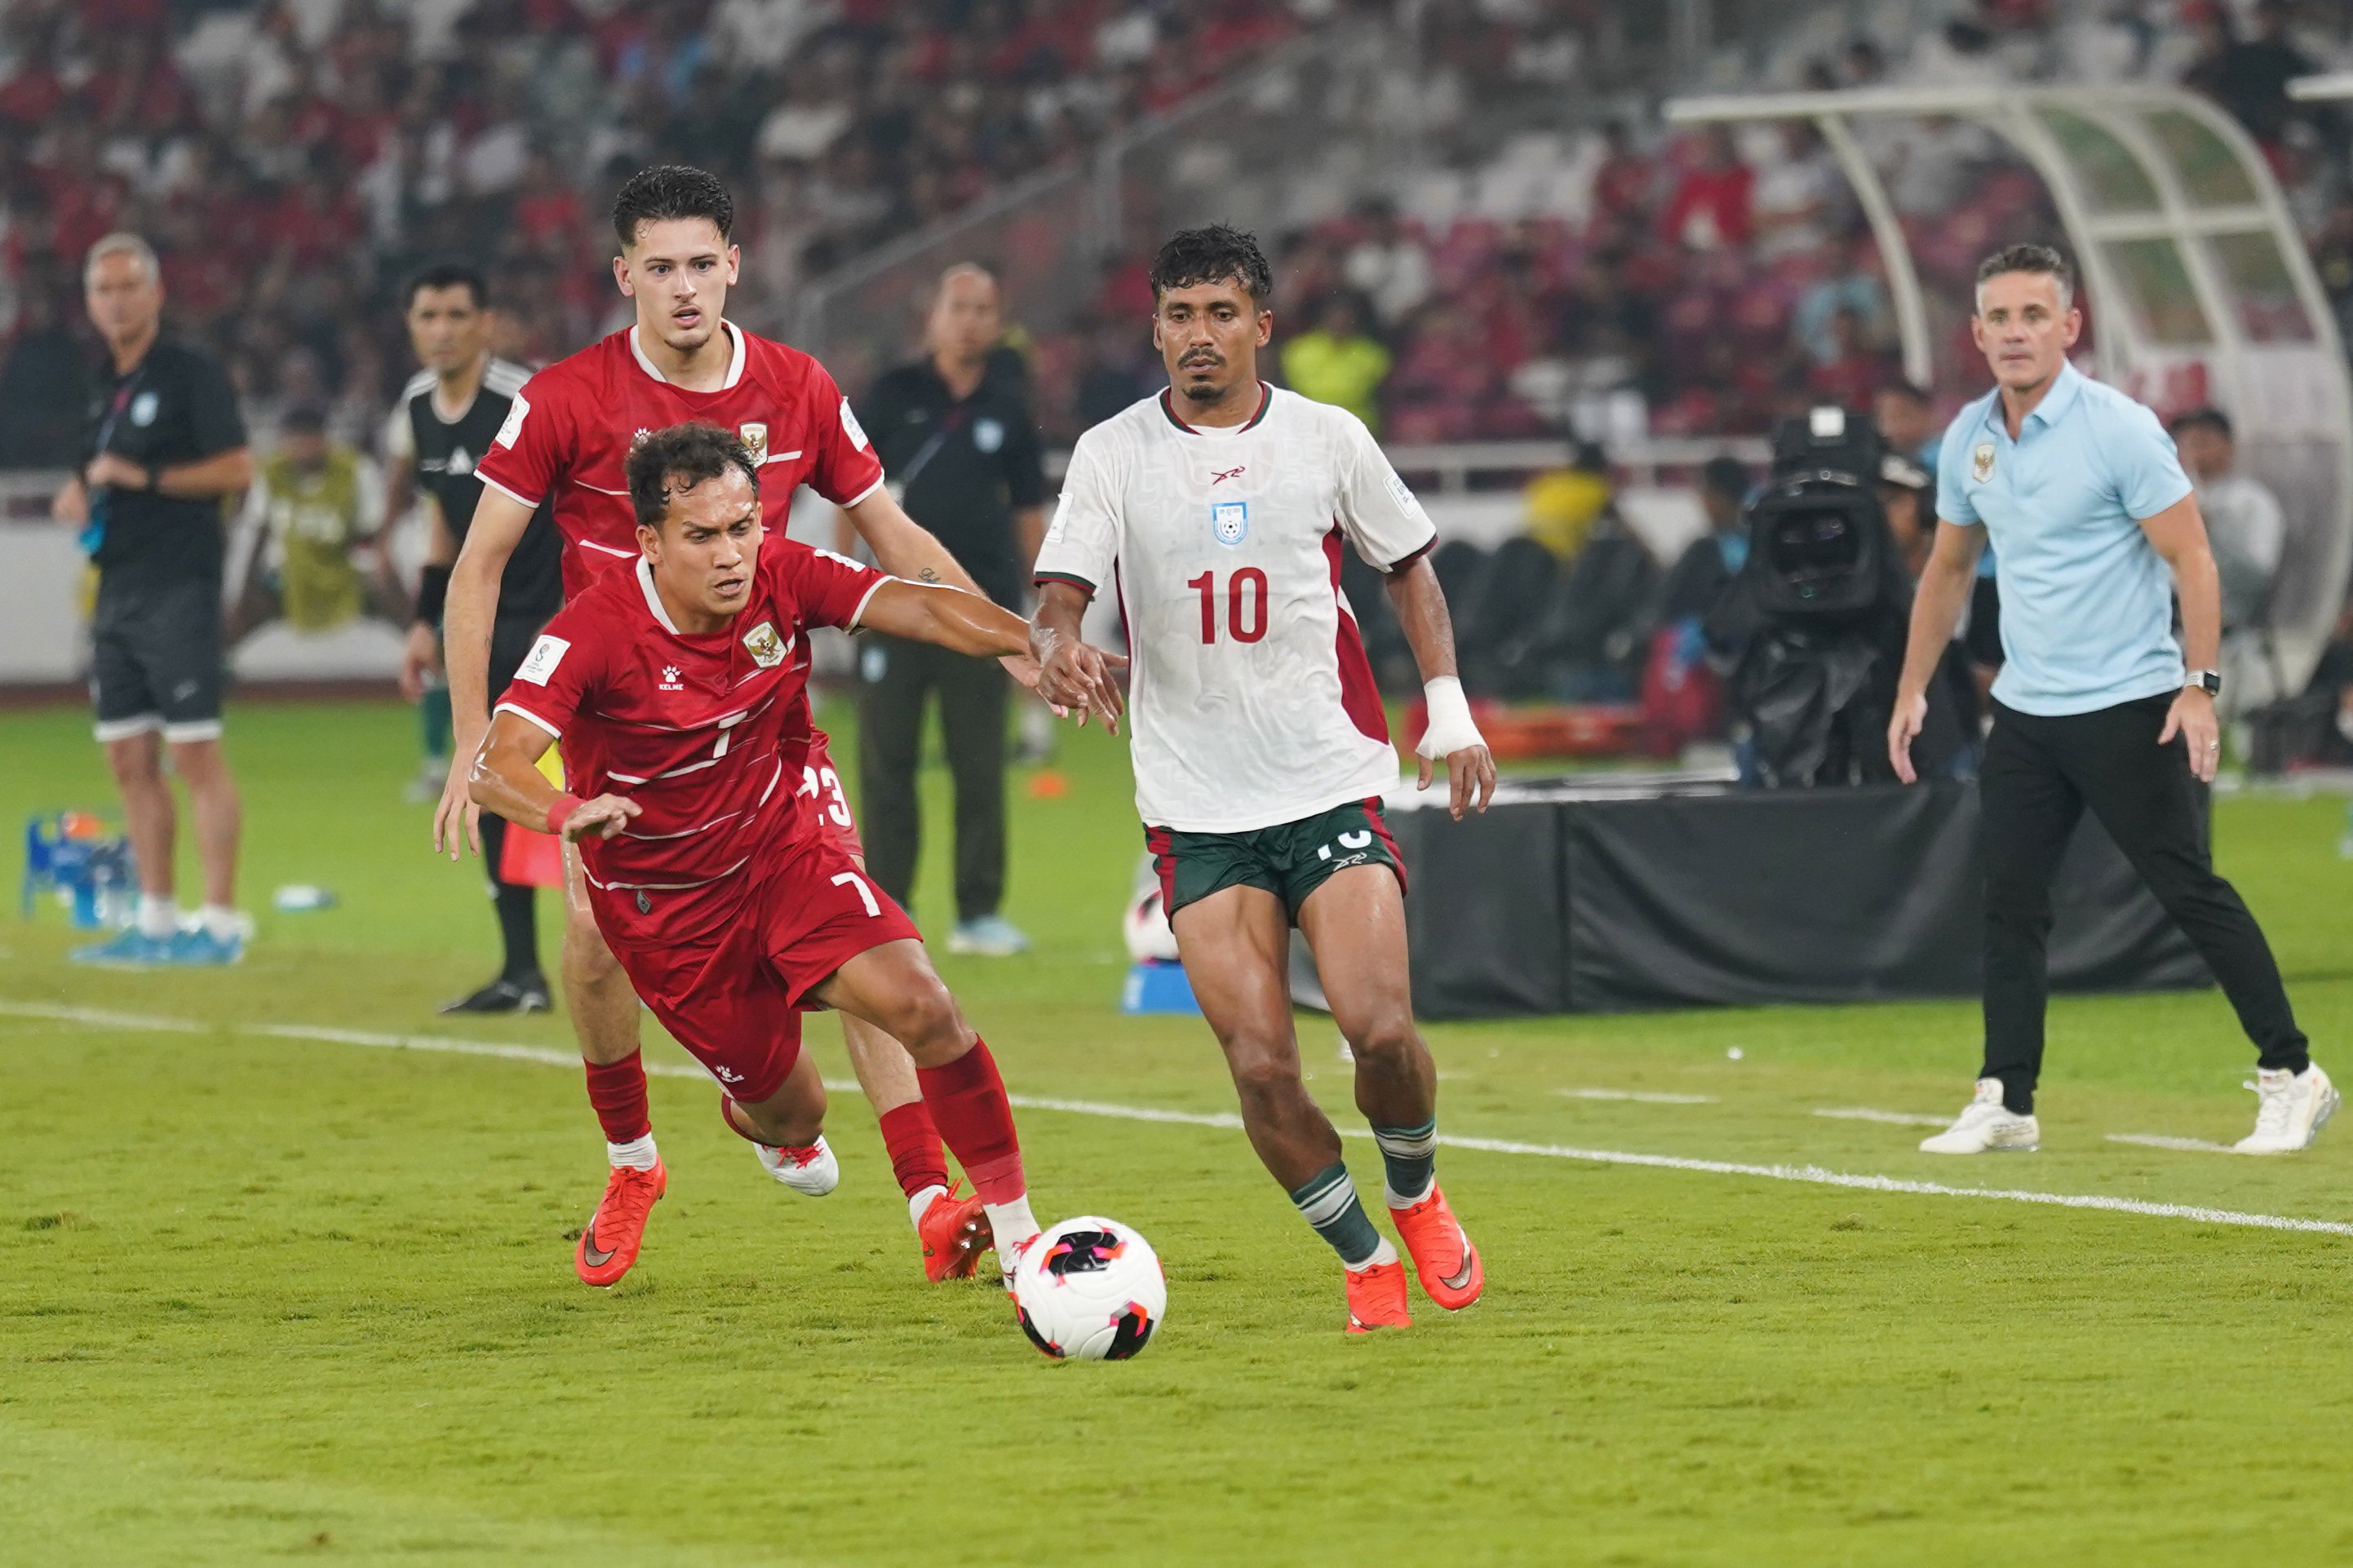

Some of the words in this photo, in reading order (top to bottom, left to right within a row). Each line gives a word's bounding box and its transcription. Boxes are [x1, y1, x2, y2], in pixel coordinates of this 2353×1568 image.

[1188, 567, 1268, 644] 10
[712, 711, 748, 759] 7
[830, 871, 882, 918] 7
